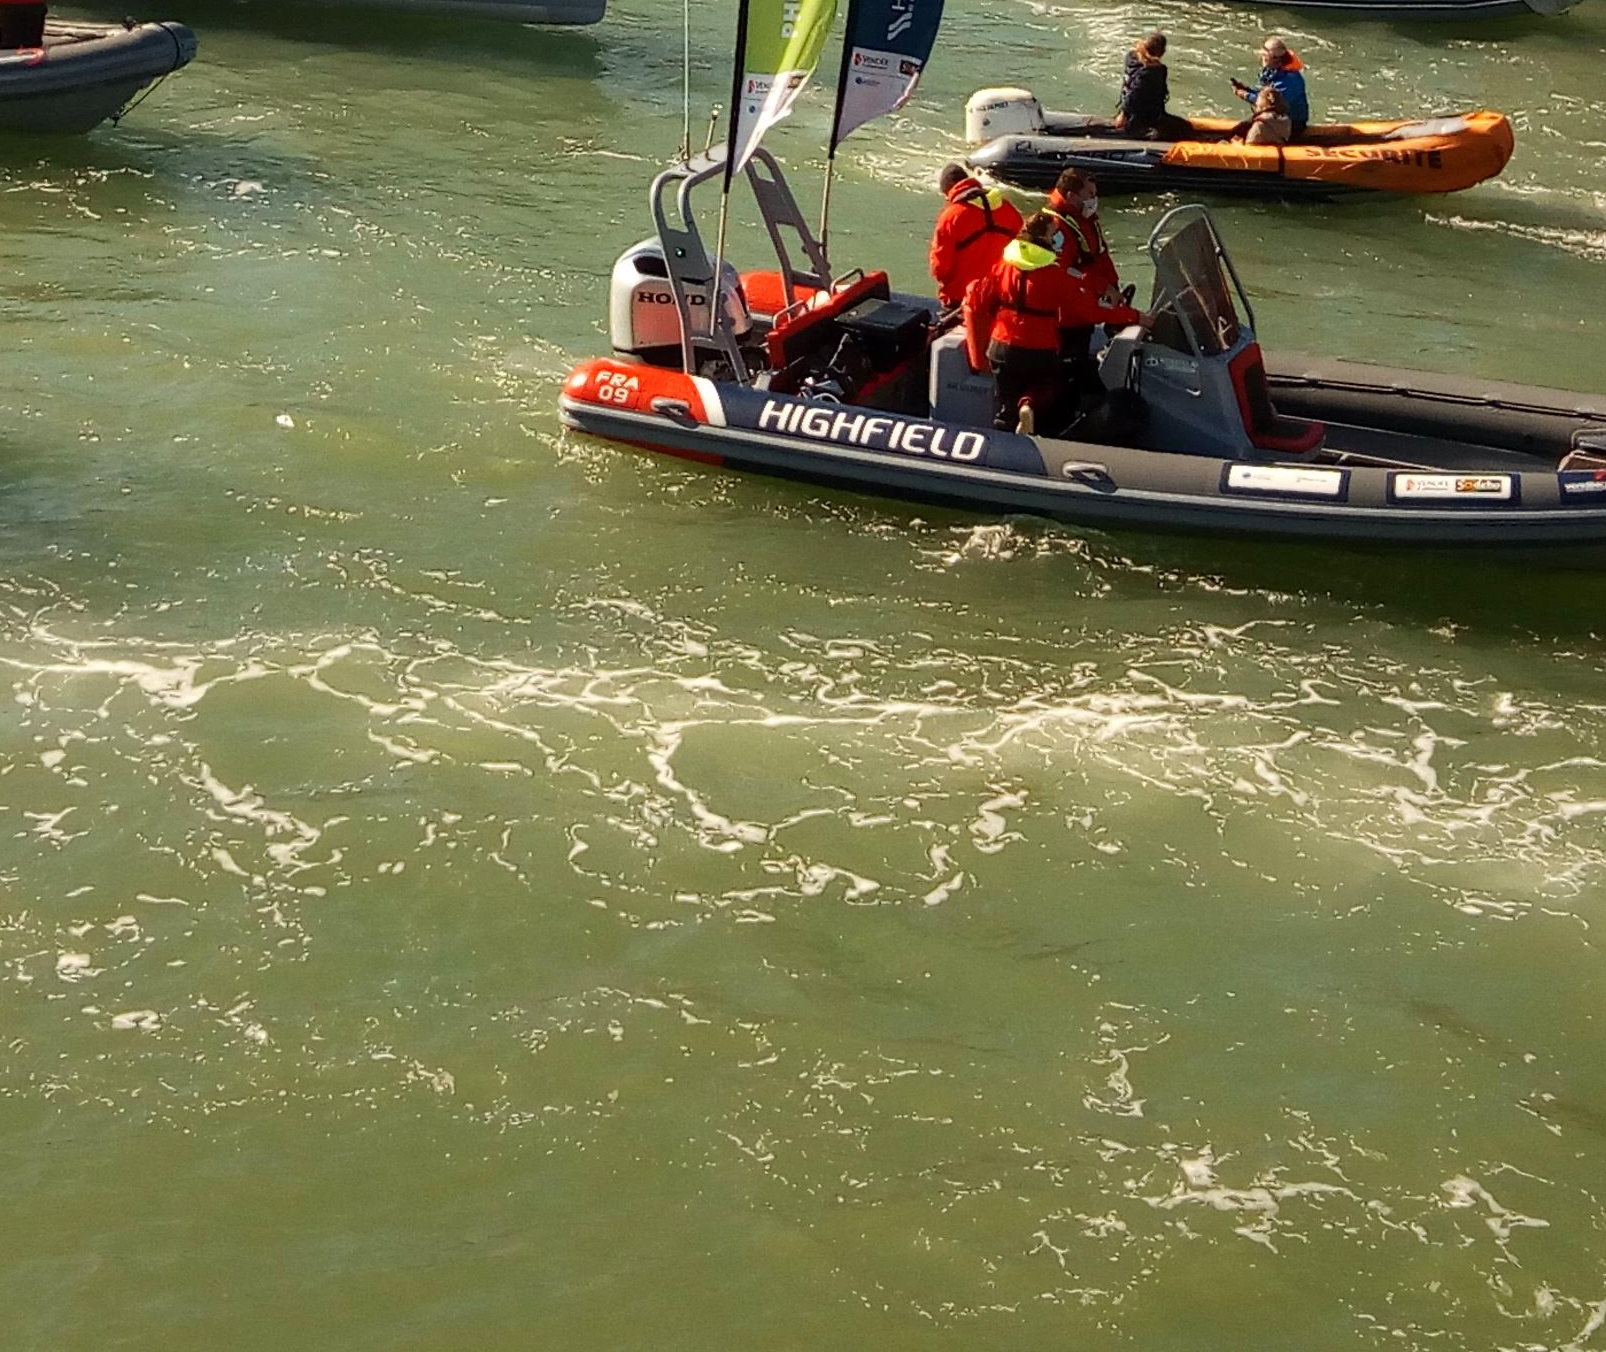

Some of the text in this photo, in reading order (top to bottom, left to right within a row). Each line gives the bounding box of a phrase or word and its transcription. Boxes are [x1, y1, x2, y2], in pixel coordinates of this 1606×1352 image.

[637, 290, 706, 306] HOD
[594, 369, 639, 390] FRA
[597, 386, 629, 404] 09
[758, 399, 986, 462] HIGHFIELD
